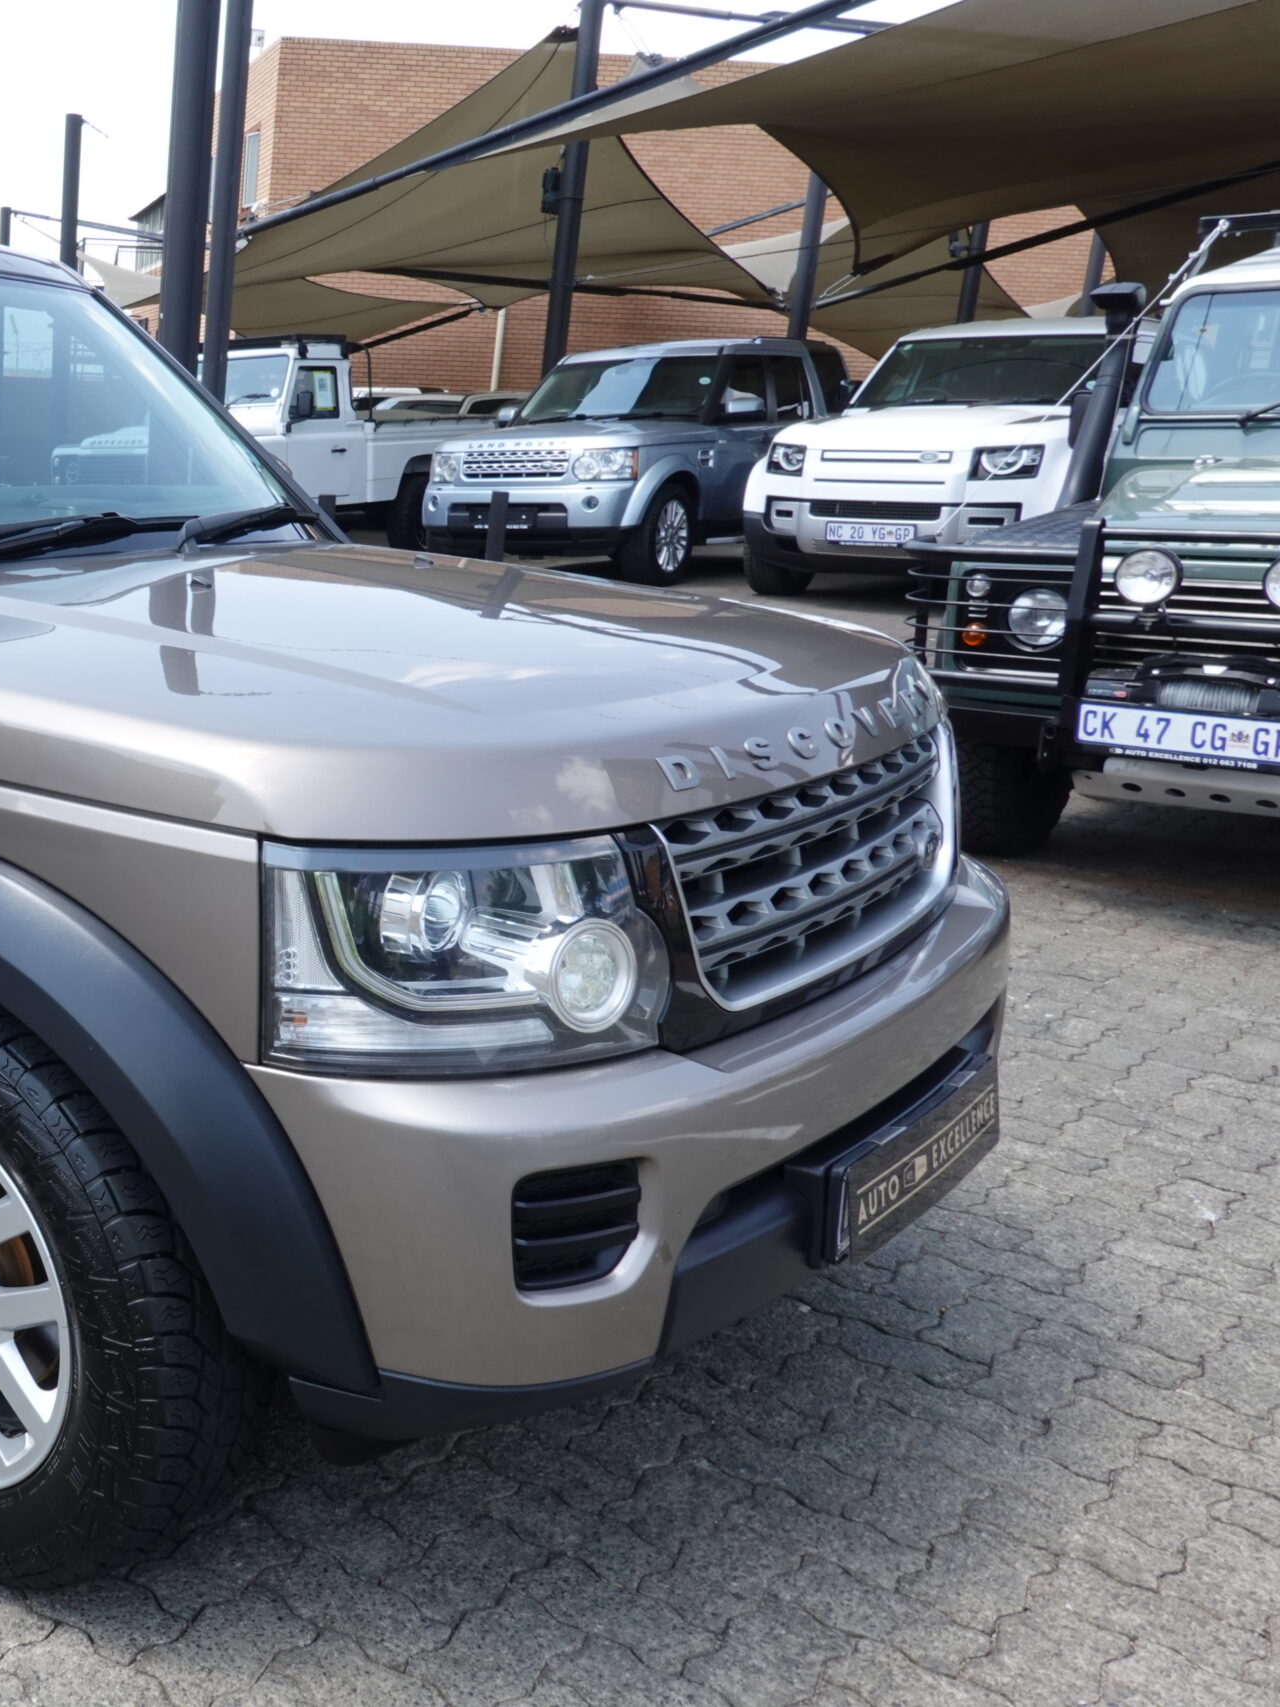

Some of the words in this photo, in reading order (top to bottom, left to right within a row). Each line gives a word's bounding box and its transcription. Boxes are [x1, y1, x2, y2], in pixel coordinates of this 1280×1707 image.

[828, 525, 843, 539] NC
[850, 526, 865, 540] 20
[871, 527, 886, 540] YG
[895, 528, 910, 541] GP
[654, 679, 933, 792] DISCOVERY
[1082, 709, 1117, 740] CK
[1136, 715, 1172, 745] 47
[1190, 721, 1228, 752] CG
[1125, 748, 1146, 757] AUTO
[1148, 752, 1201, 763] EXCELLENCE
[1202, 757, 1218, 766] 012
[858, 1174, 900, 1226] AUTO
[932, 1092, 995, 1169] EXCELLENCE
